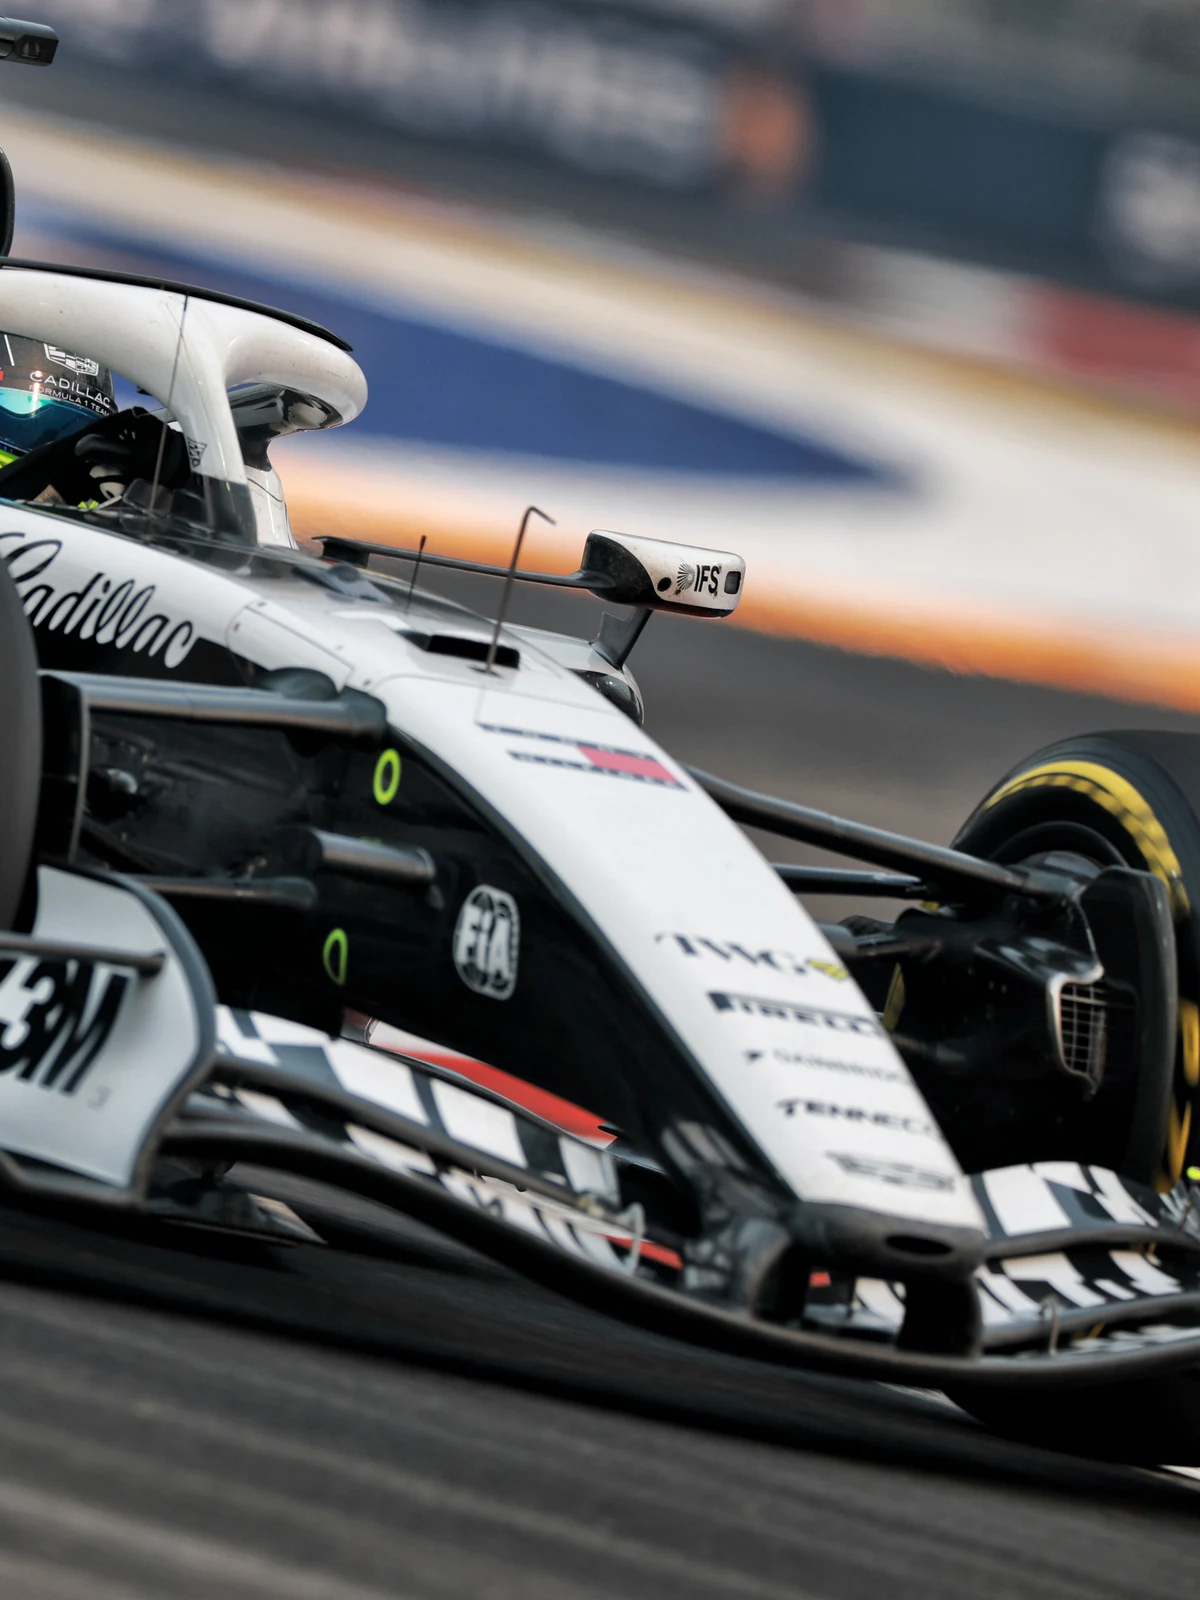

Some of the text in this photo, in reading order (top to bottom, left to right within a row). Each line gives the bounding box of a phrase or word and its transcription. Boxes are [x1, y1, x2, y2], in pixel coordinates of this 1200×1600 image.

[28, 384, 82, 405] FORMULA
[29, 370, 111, 408] CADILLAC
[693, 564, 722, 594] IFS
